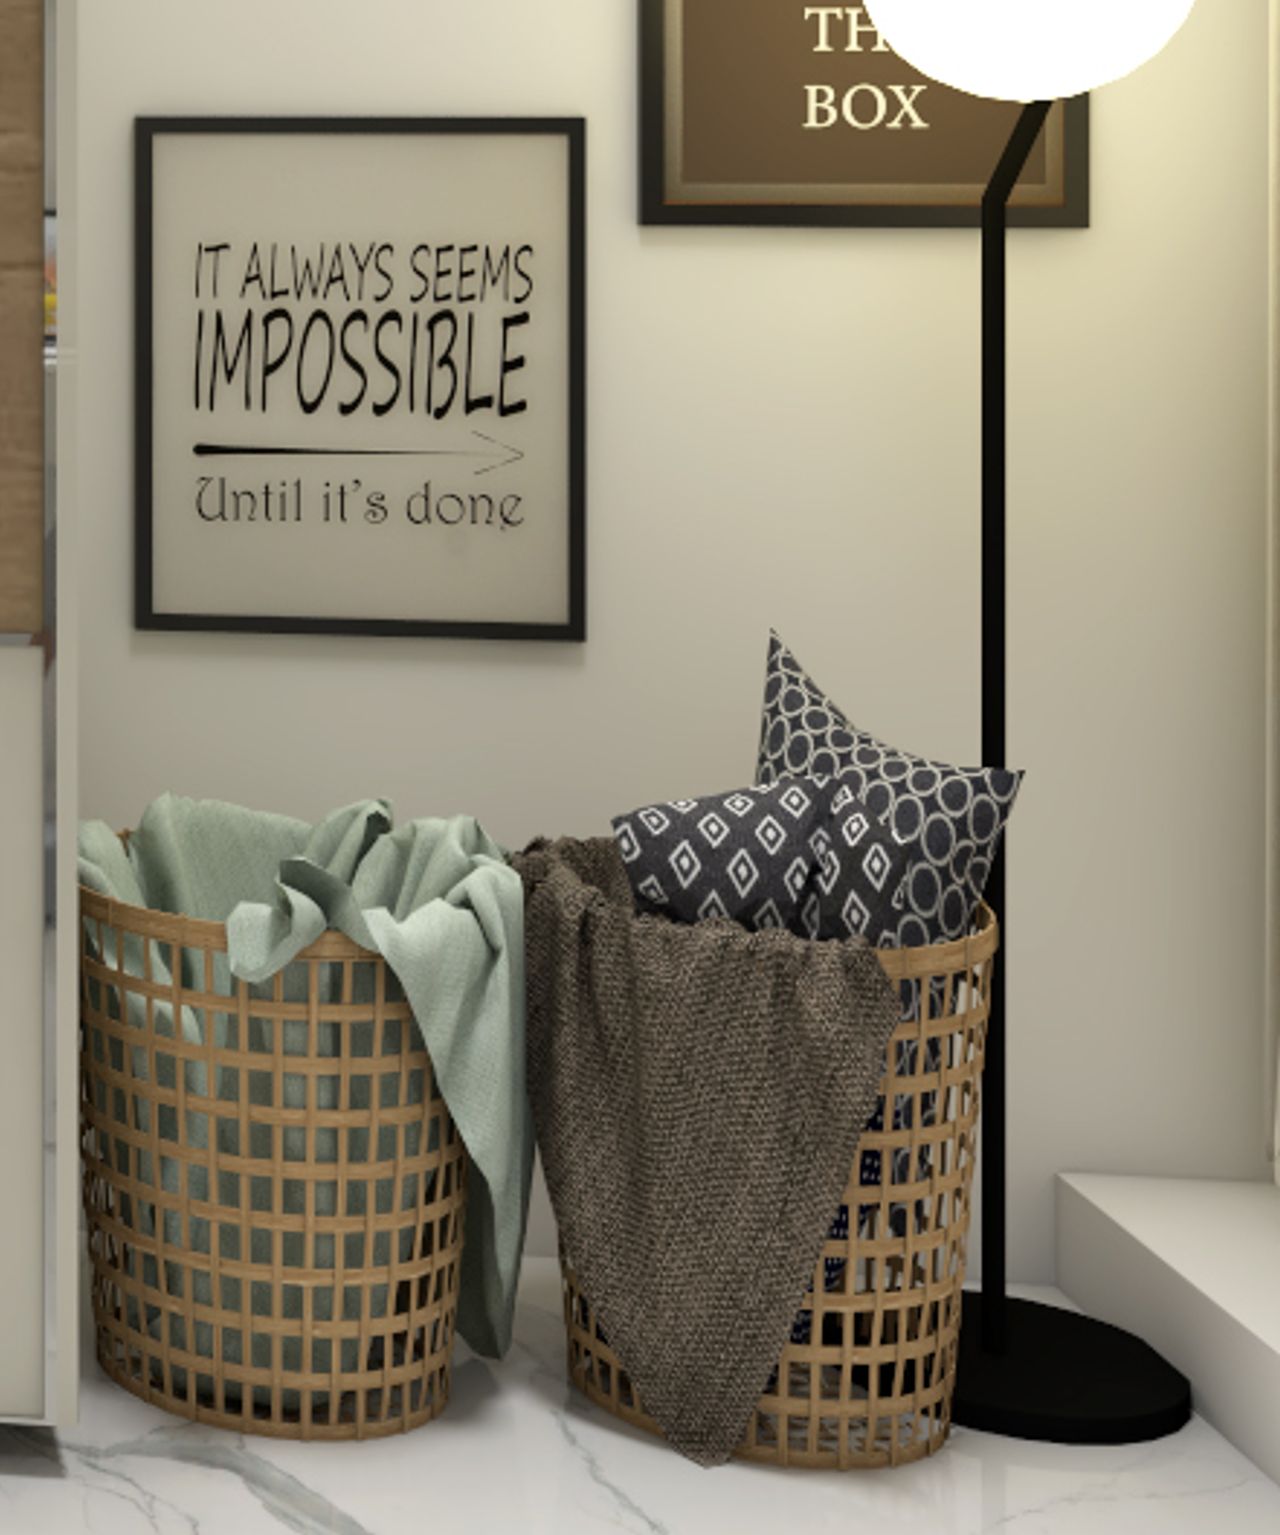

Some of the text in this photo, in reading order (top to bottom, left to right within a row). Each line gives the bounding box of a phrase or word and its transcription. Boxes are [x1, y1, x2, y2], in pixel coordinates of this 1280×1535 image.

[803, 6, 891, 53] TH
[802, 83, 930, 130] BOX
[195, 241, 534, 305] IT ALWAYS SEEMS
[194, 307, 531, 421] IMPOSSIBLE
[195, 476, 525, 531] Until it's done
